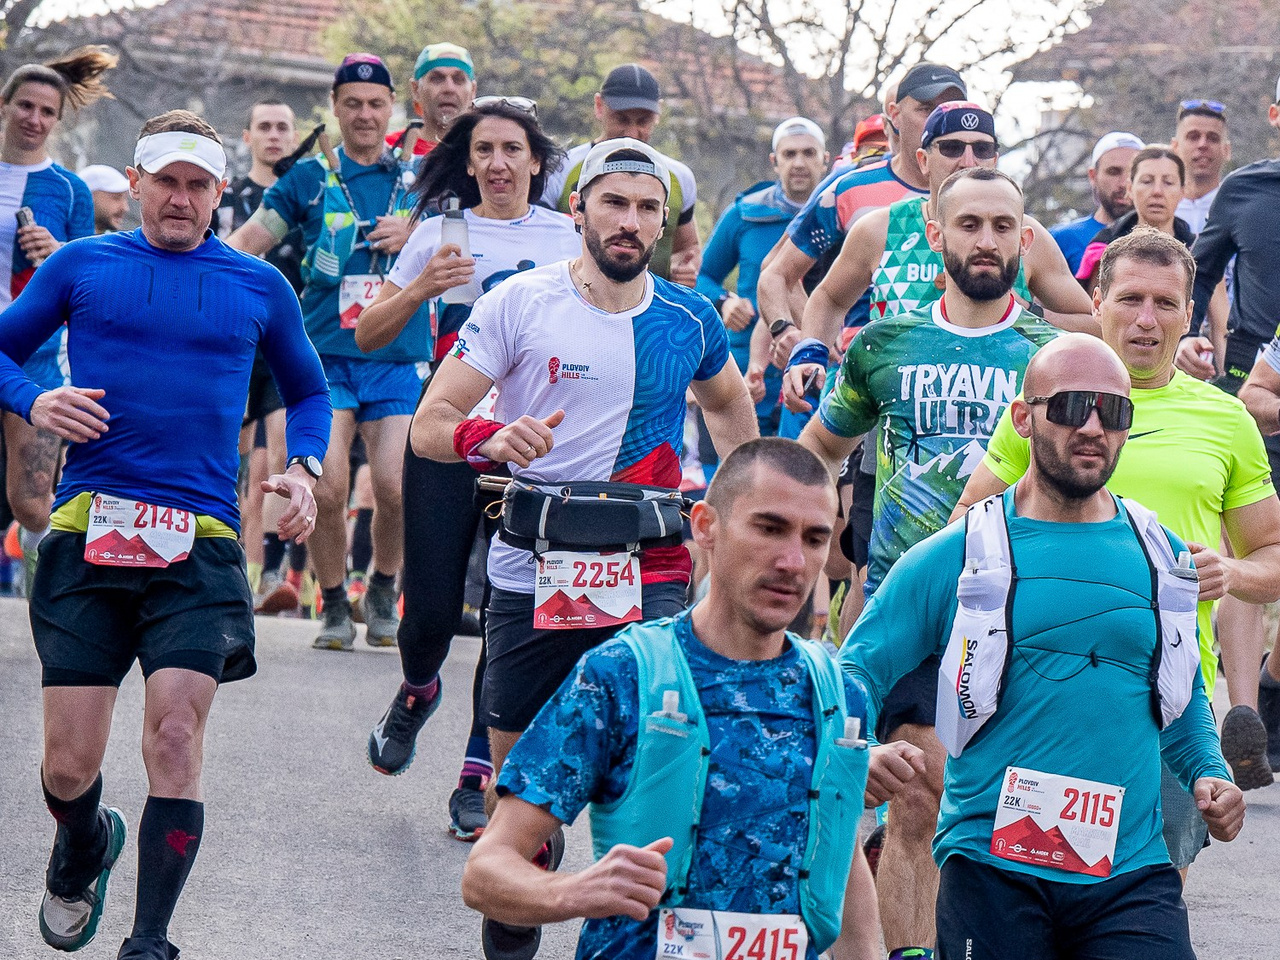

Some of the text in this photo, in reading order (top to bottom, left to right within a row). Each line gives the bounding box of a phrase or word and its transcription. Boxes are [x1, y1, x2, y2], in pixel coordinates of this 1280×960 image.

[562, 363, 590, 372] PLOVDIV
[93, 515, 108, 524] 22K
[134, 501, 190, 533] 2143
[572, 559, 635, 588] 2254
[538, 576, 552, 585] 22K
[960, 639, 979, 720] SALOMON
[1018, 778, 1040, 787] PLOVDIV
[1003, 795, 1021, 807] 22K
[1060, 787, 1116, 828] 2115
[664, 943, 684, 956] 22K
